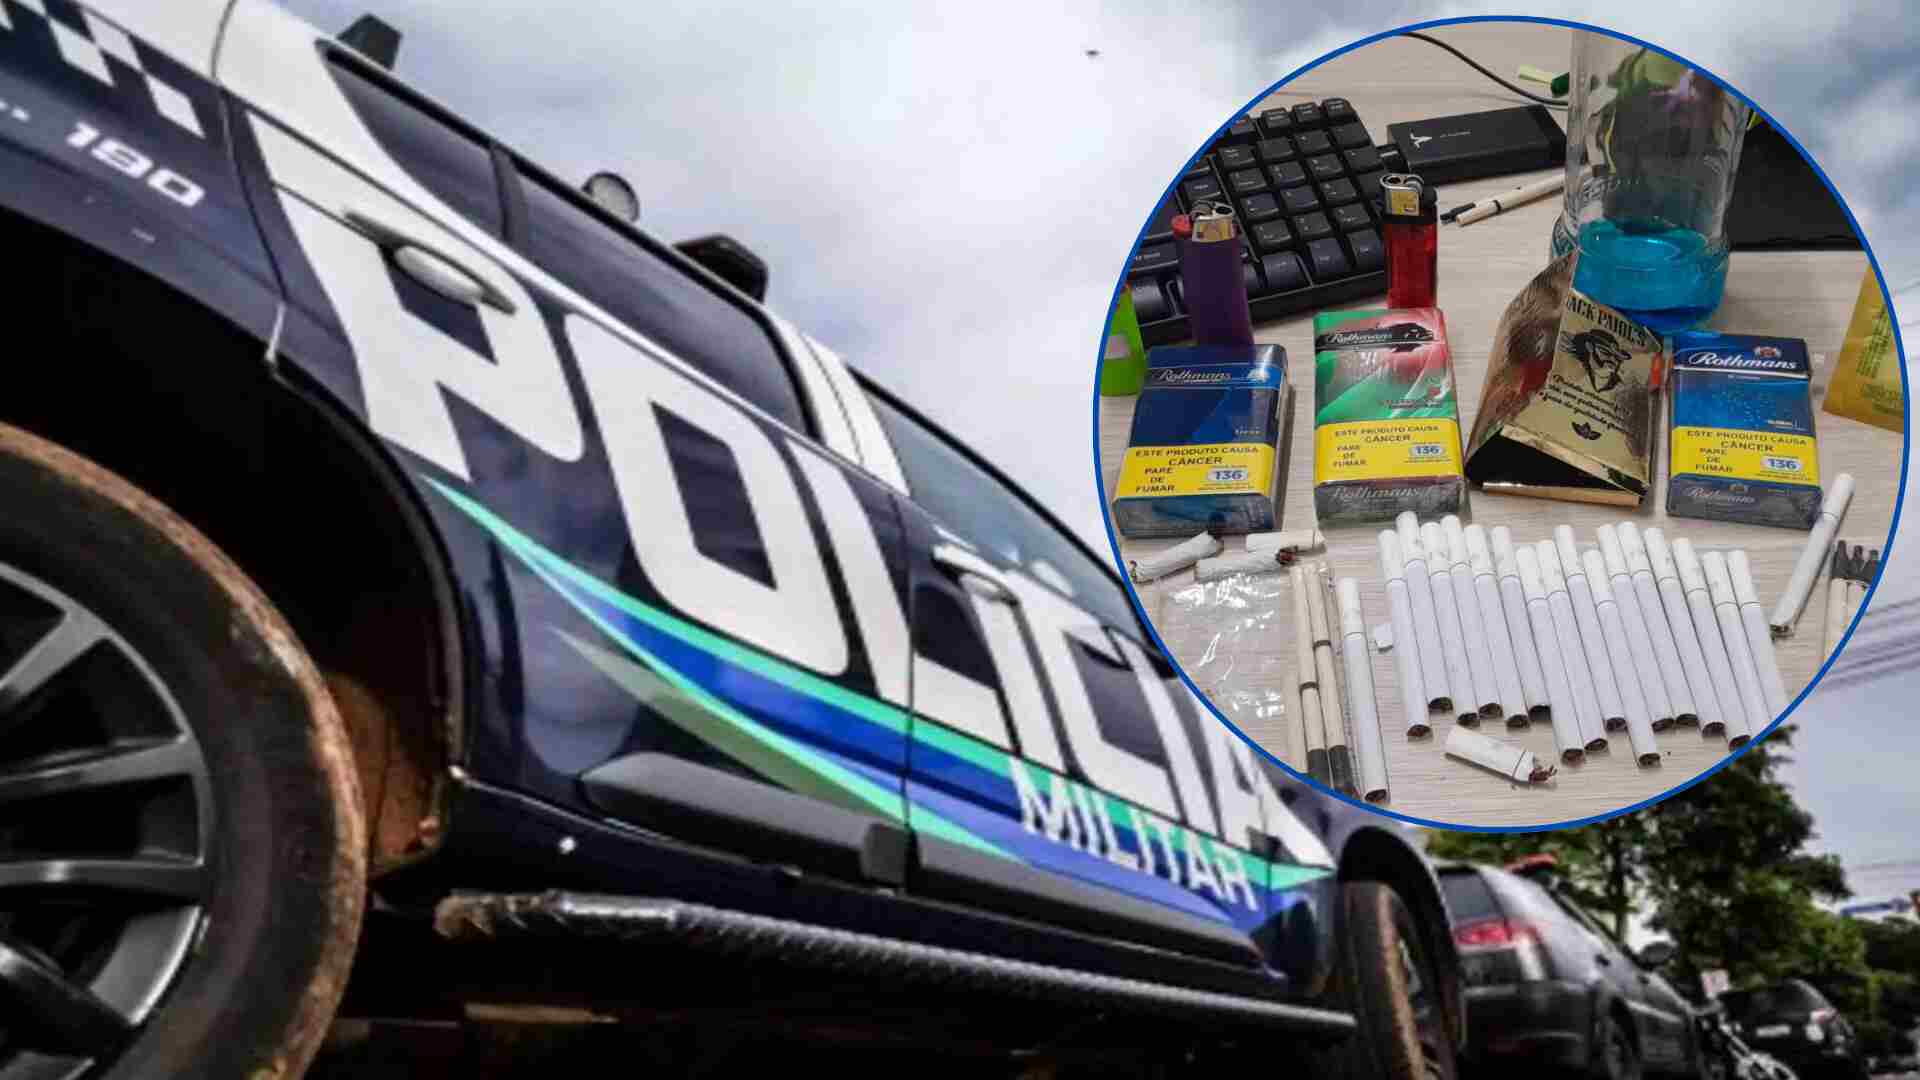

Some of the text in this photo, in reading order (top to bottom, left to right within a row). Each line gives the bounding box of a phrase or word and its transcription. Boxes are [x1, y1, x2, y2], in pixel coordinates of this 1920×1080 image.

[67, 121, 206, 207] 190
[1687, 352, 1798, 370] Rothmans
[1158, 367, 1232, 383] Rothmans
[1687, 429, 1807, 446] ESTE PRODUTO CAUSA
[1135, 448, 1162, 457] ESTE
[1166, 447, 1218, 456] PRODUTO
[1416, 445, 1439, 454] 136
[1699, 447, 1728, 456] PARE
[1695, 463, 1733, 473] FUMAR
[1767, 458, 1797, 471] 136
[1214, 469, 1242, 481] 136
[1135, 484, 1175, 493] FUMAR
[1008, 755, 1259, 912] MILITAR
